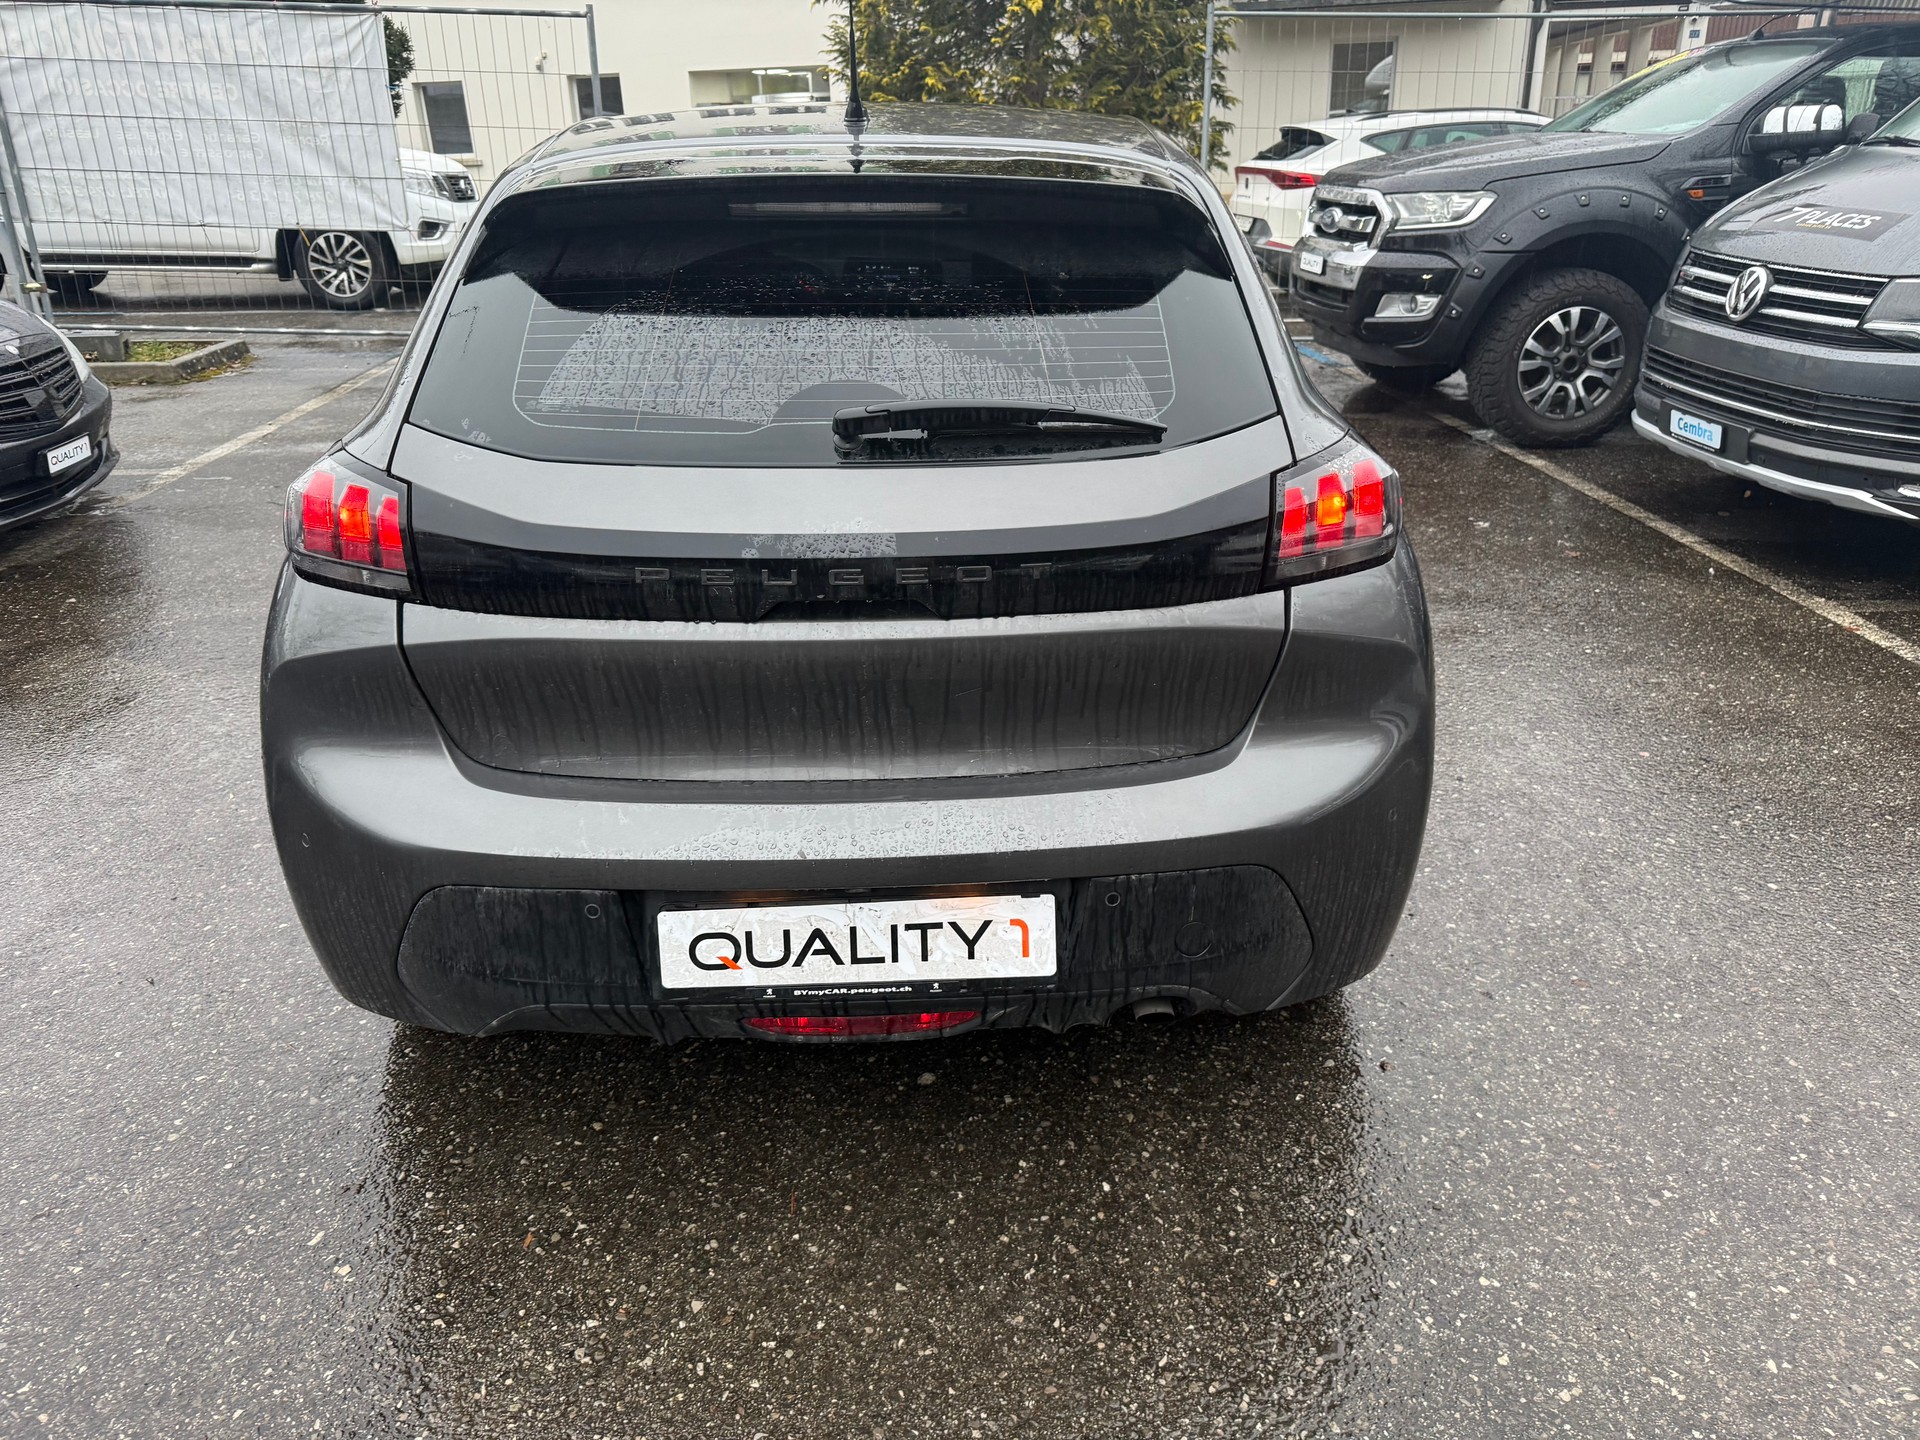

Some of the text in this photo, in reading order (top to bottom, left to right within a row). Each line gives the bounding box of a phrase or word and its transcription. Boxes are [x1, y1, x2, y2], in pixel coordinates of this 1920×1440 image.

[1795, 208, 1882, 229] PLACES
[1677, 417, 1713, 442] Cembra
[634, 561, 1053, 586] PEUGEOT
[688, 919, 993, 971] QUALITY
[793, 985, 913, 997] BYmyCAR.peugeot.ch
